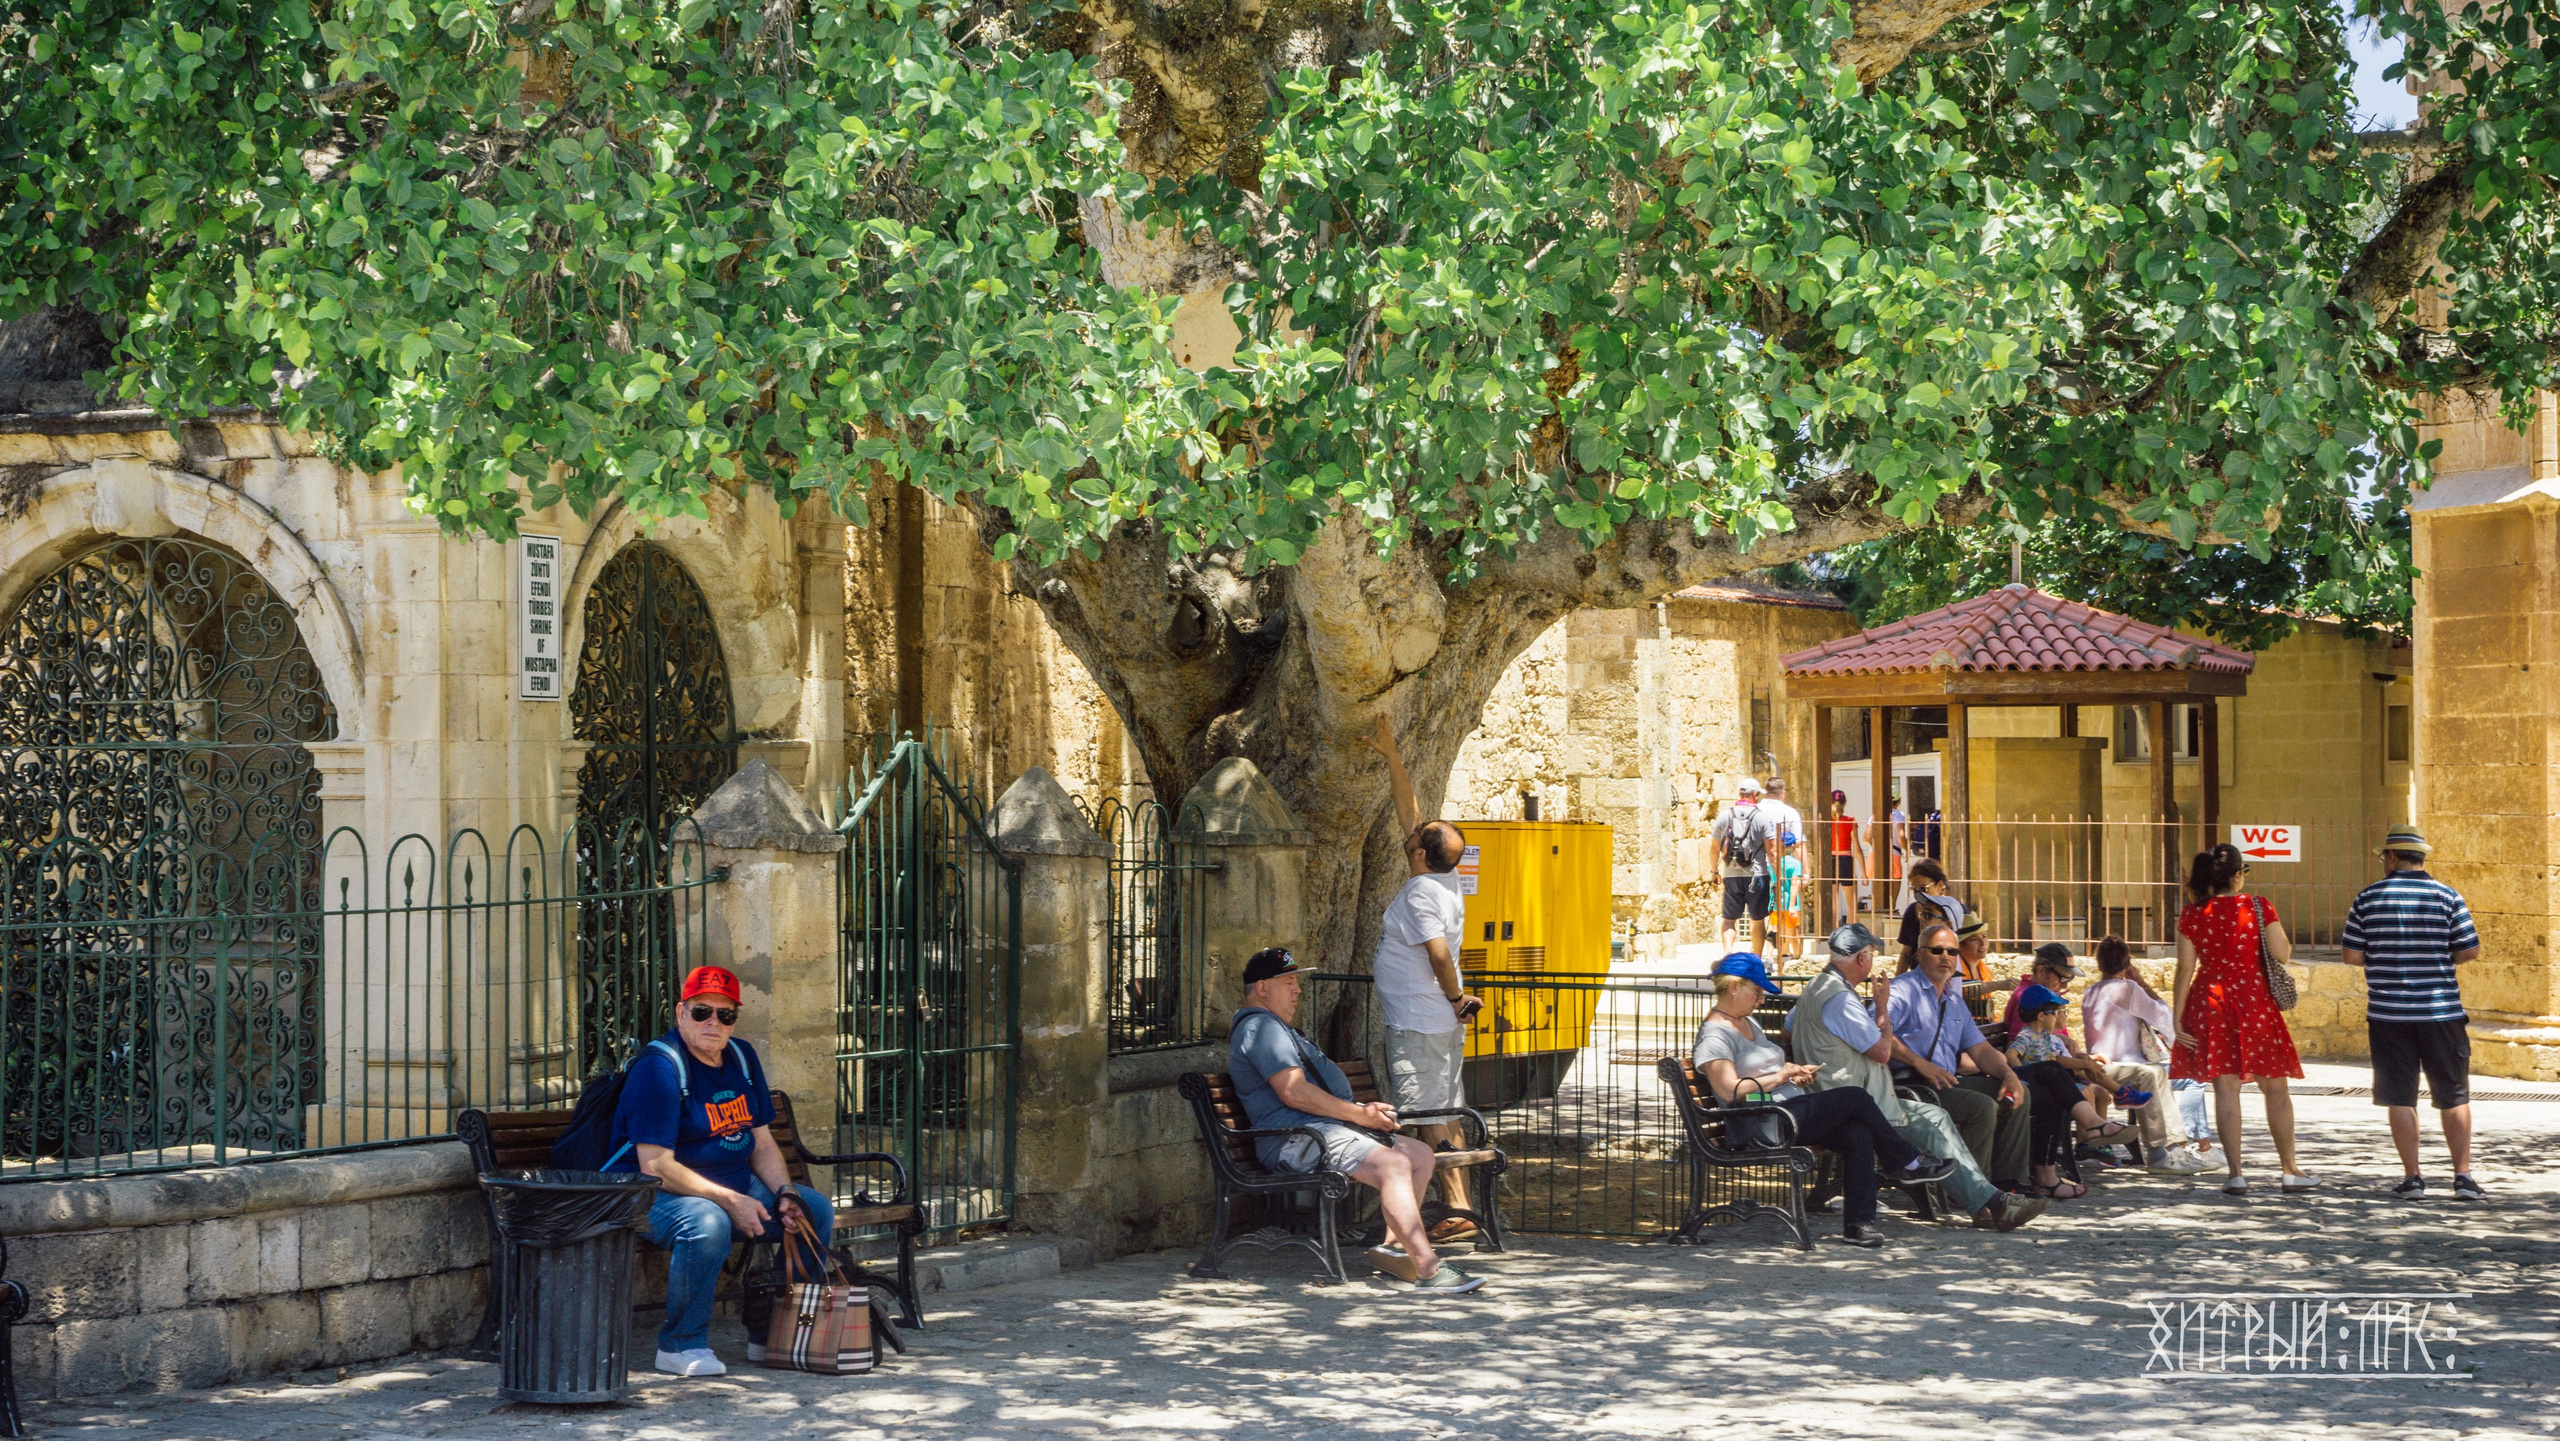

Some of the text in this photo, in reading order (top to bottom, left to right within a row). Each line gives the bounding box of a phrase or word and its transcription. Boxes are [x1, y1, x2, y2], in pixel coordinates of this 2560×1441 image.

[527, 543, 554, 560] MUSTAFA
[531, 560, 550, 578] ZÜHTÜ
[531, 580, 551, 597] EFENDİ
[529, 598, 554, 616] TÜRBESİ
[530, 619, 552, 635] SHRINE
[537, 638, 545, 653] OF
[525, 657, 557, 673] MUSTAPHA
[2241, 828, 2289, 844] WC
[699, 972, 731, 985] EA7
